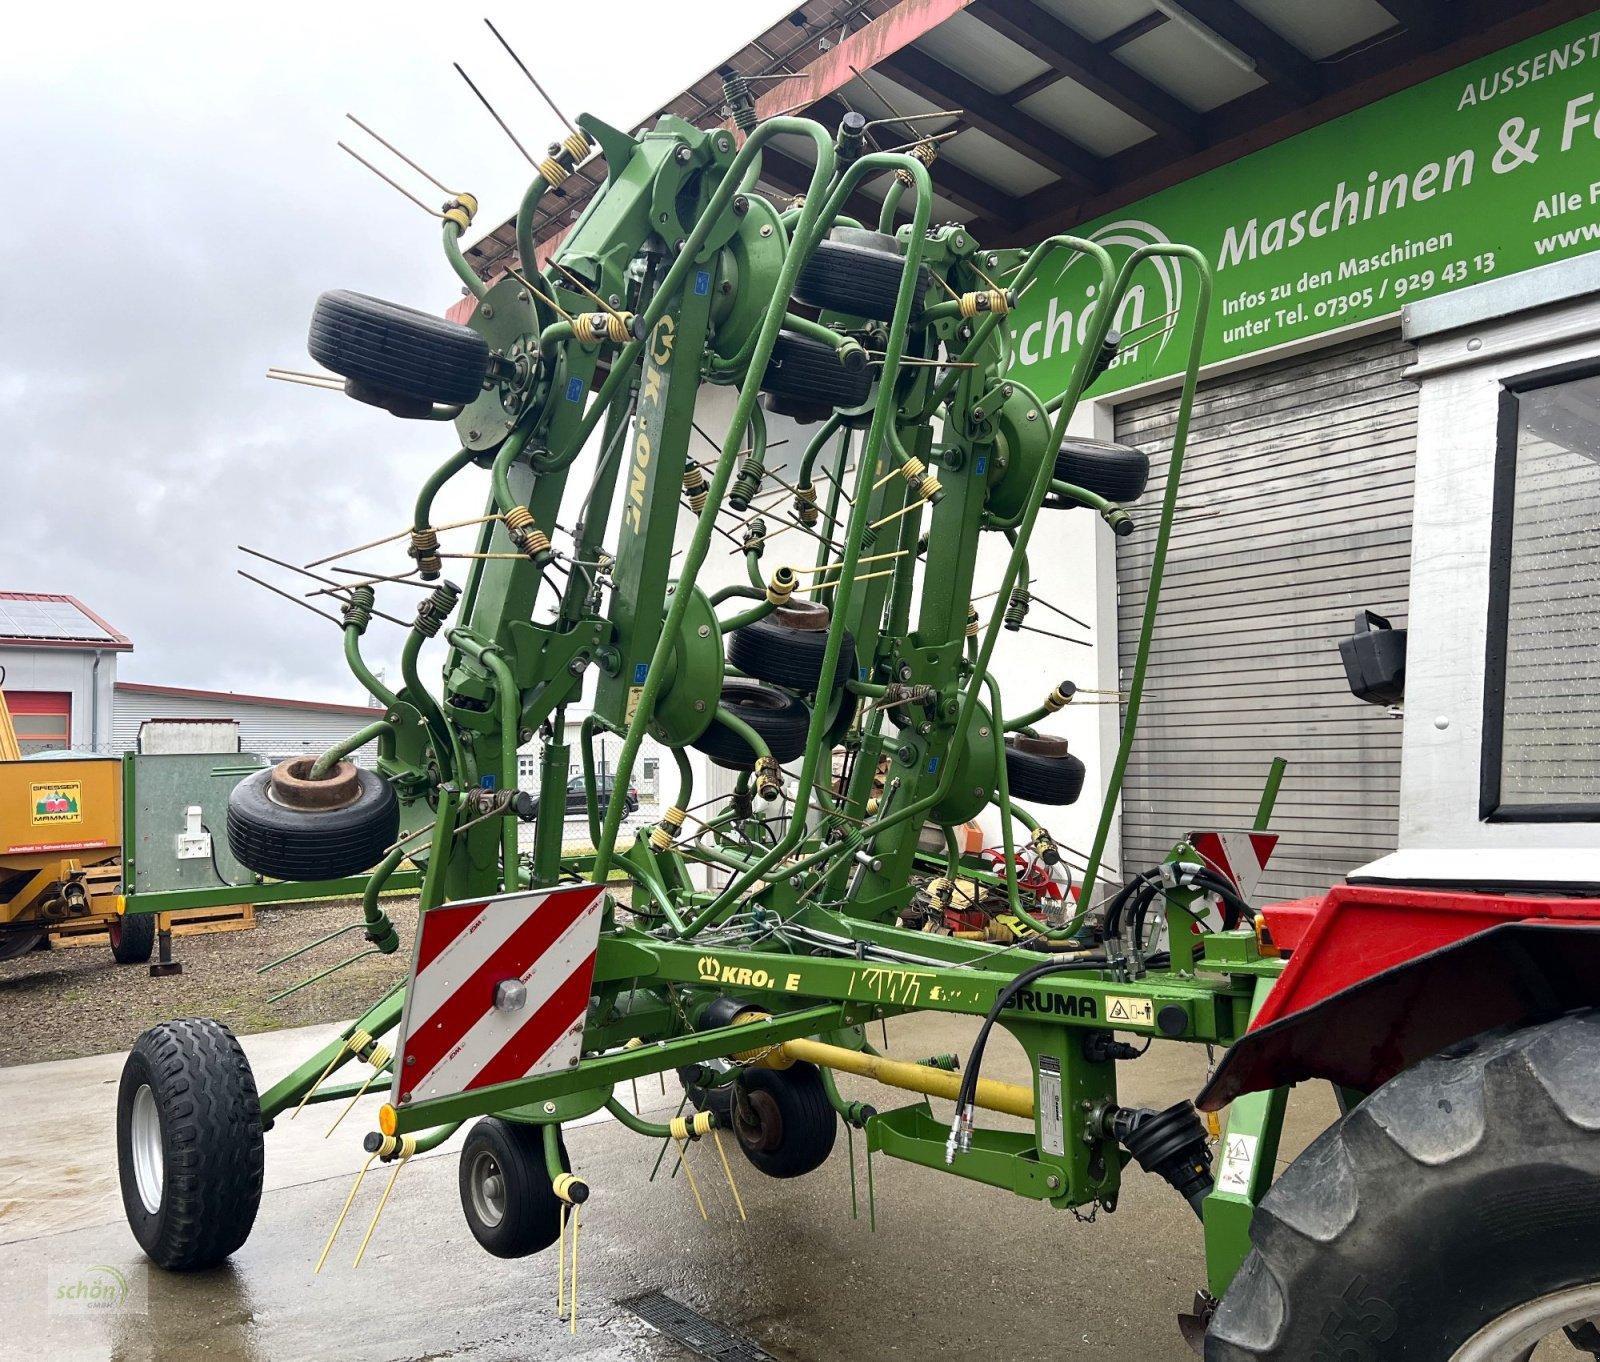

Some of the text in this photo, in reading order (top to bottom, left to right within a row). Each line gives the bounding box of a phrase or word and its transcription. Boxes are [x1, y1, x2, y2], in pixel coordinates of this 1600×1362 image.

[1457, 32, 1600, 111] AUSSENST
[1216, 92, 1600, 271] Maschinen & F
[1532, 192, 1582, 223] Alle
[1222, 232, 1453, 316] Infos zu den Maschinen
[1223, 317, 1269, 343] unter
[1275, 303, 1308, 327] Tel.
[1314, 287, 1372, 318] 07305
[1394, 270, 1435, 299] 929
[1441, 260, 1467, 283] 43
[1473, 252, 1495, 273] 13
[34, 814, 80, 822] MAMMUT
